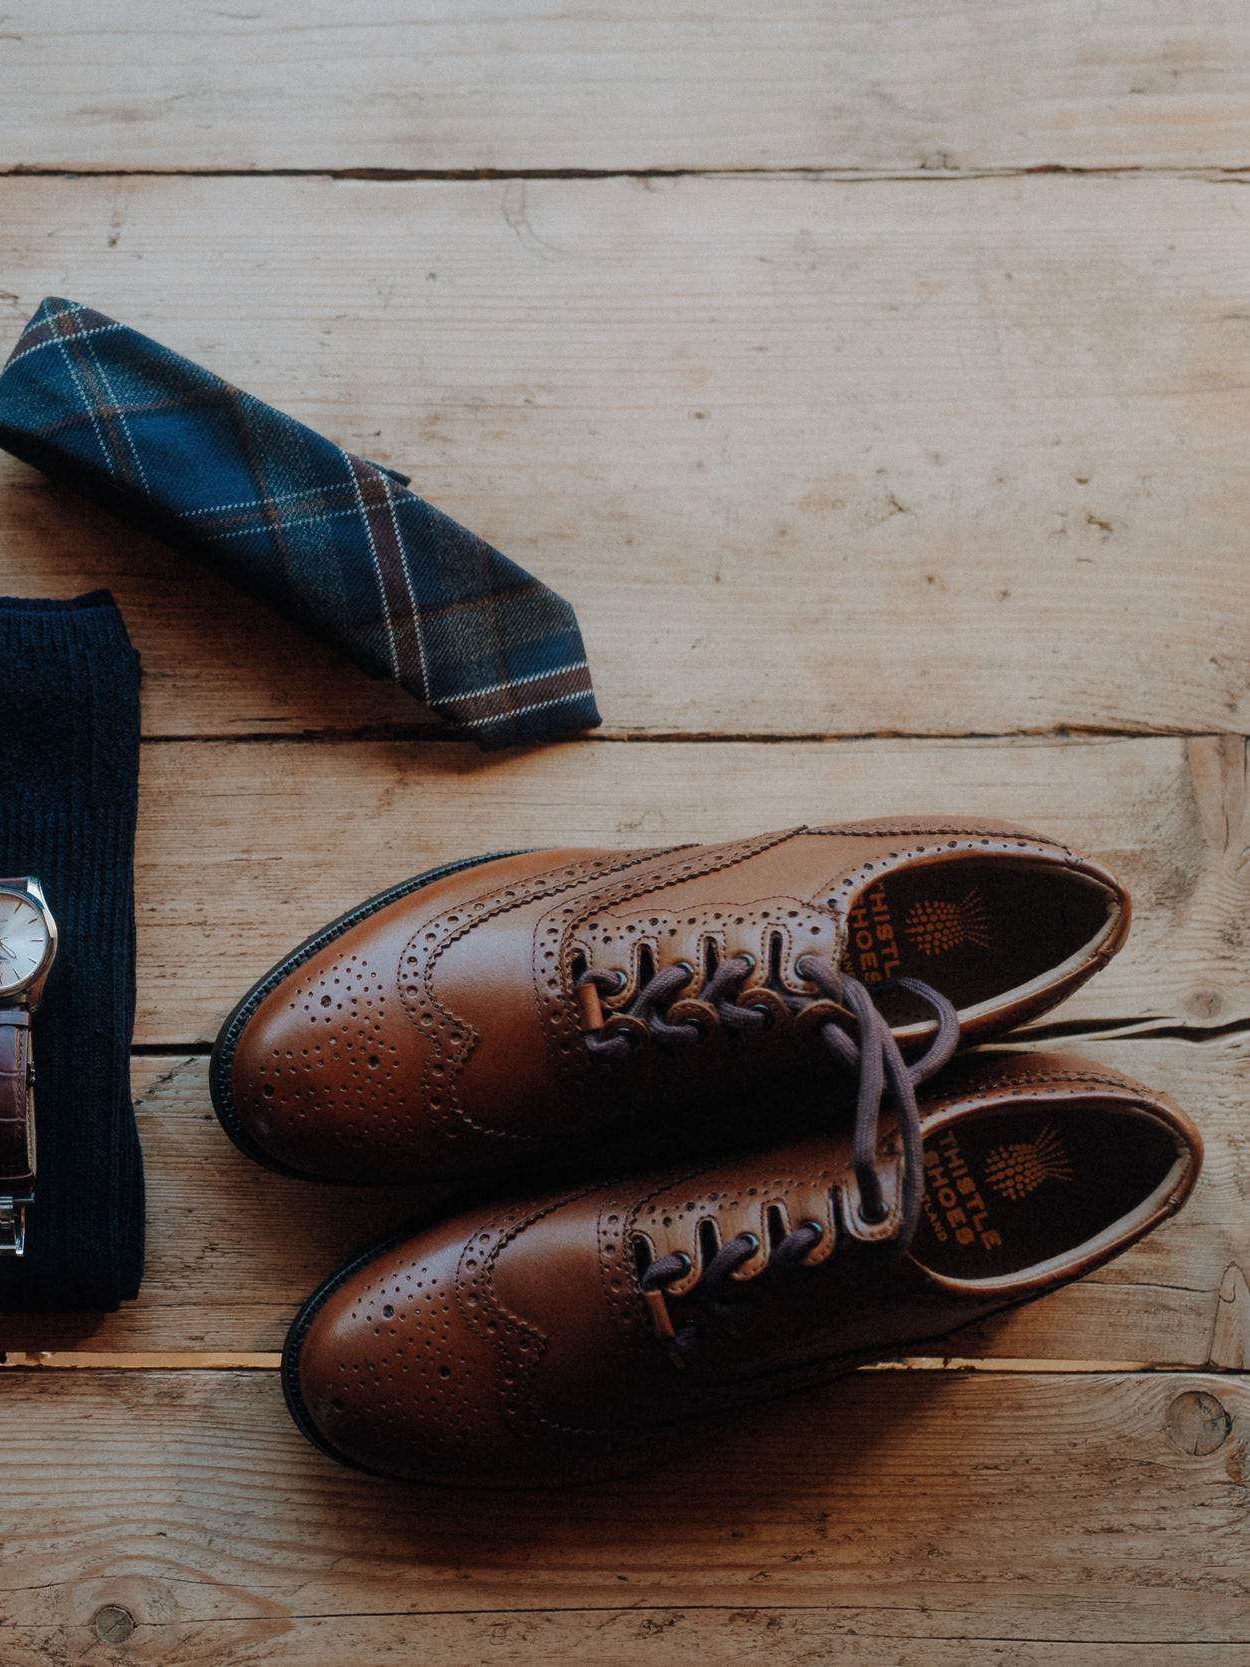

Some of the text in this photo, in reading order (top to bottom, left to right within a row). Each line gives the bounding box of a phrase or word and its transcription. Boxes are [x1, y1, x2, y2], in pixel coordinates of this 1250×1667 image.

[869, 883, 901, 980] HISTL
[922, 1150, 976, 1246] SHOES
[939, 1130, 1003, 1251] THISTLE
